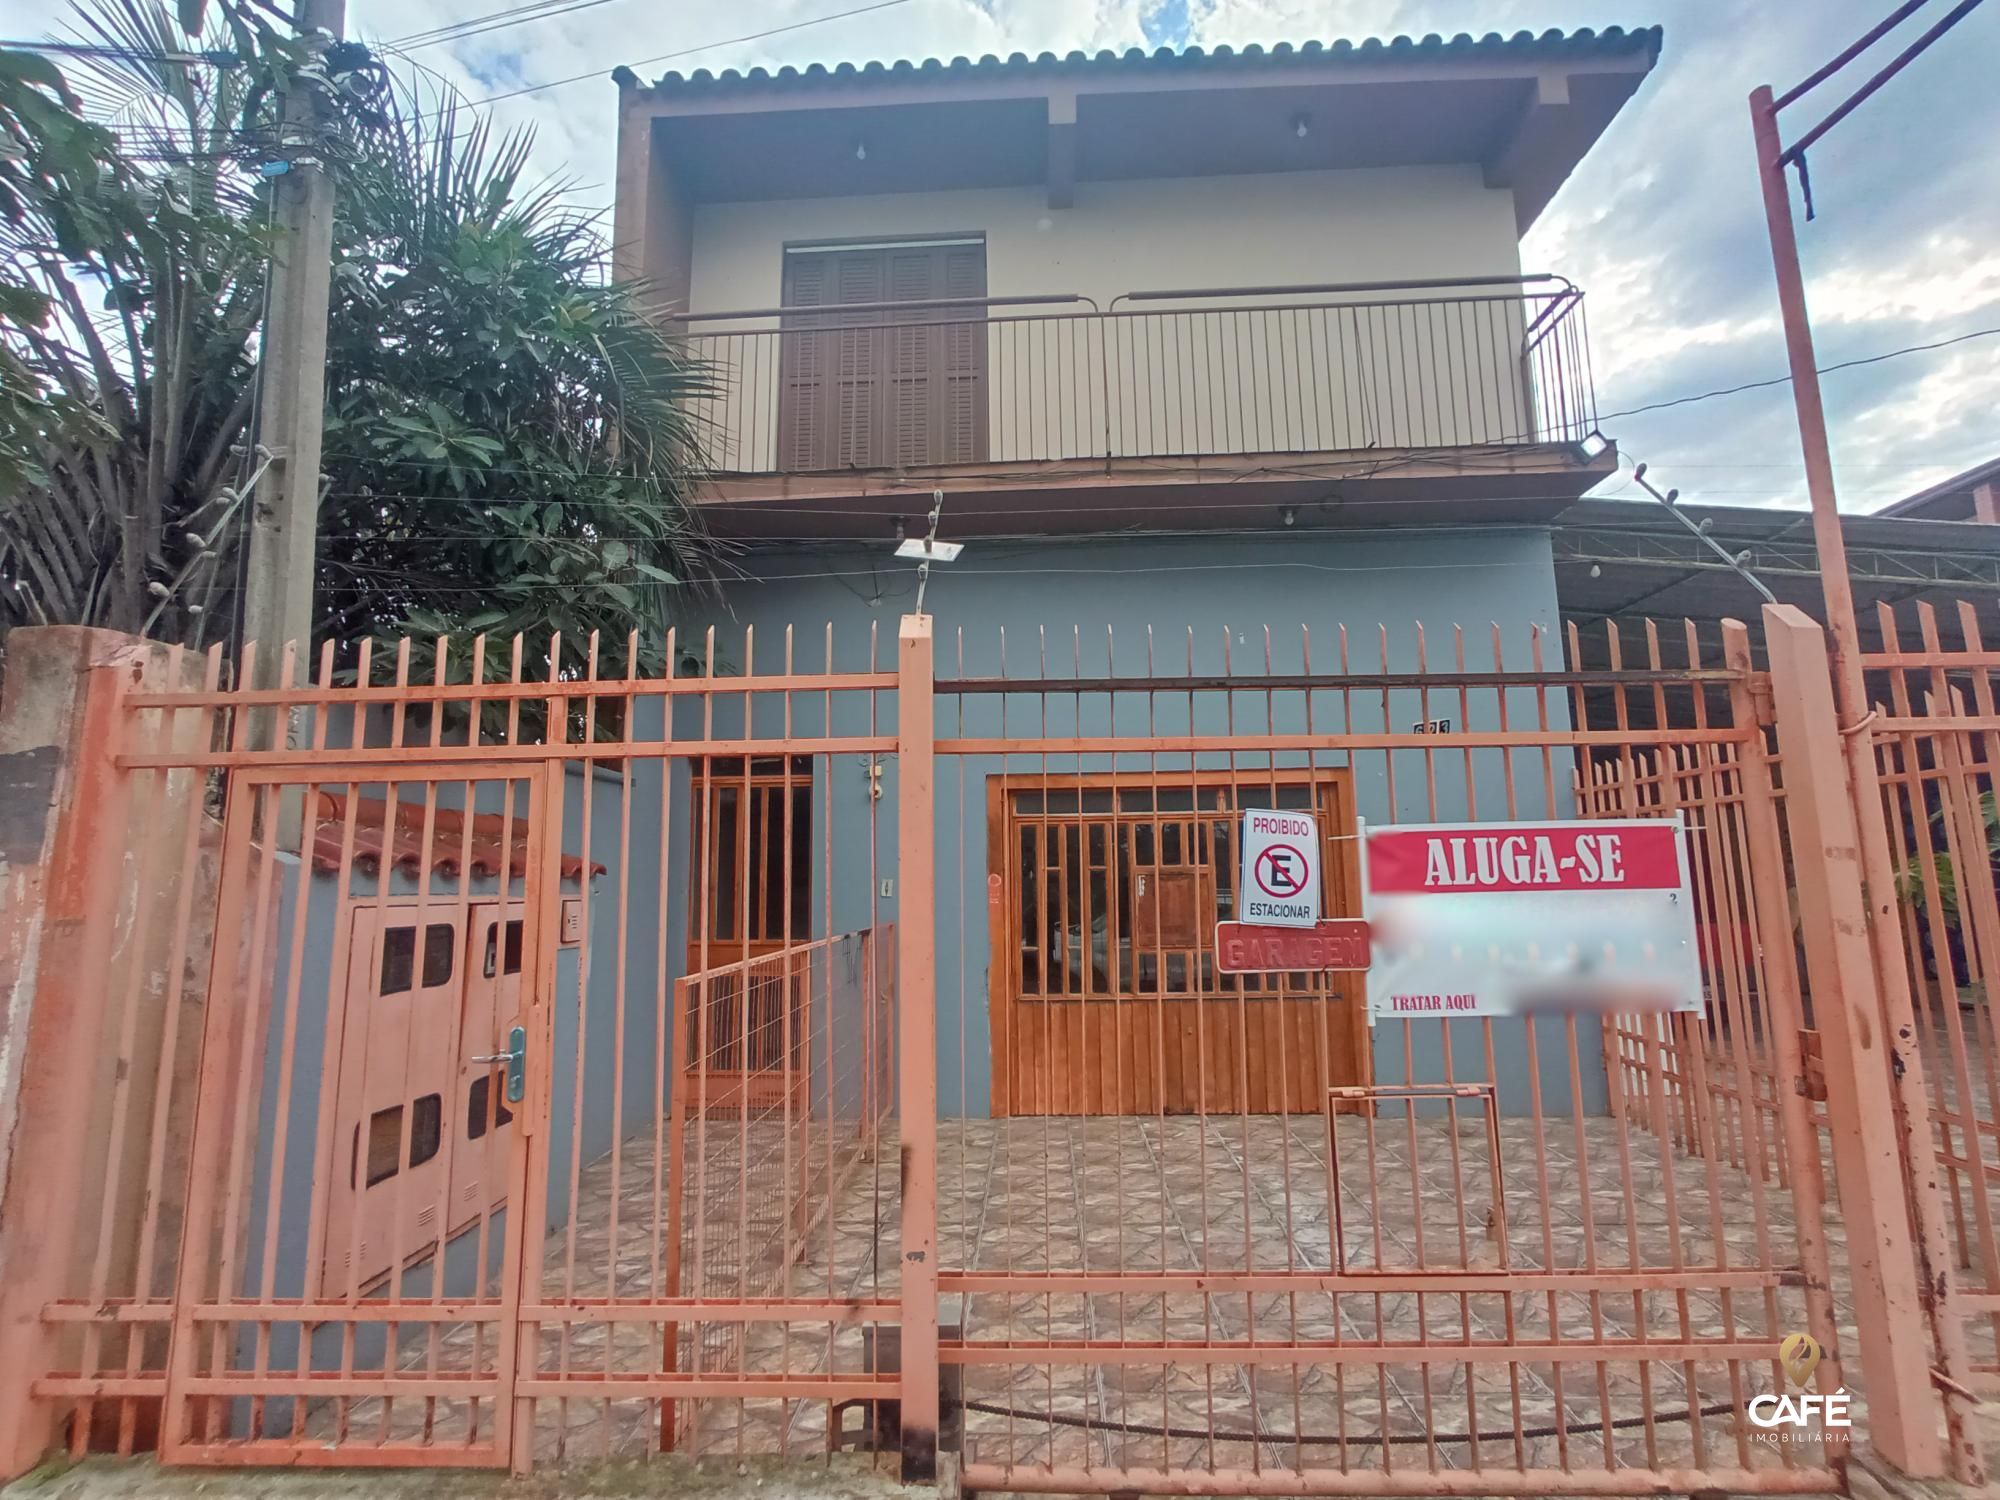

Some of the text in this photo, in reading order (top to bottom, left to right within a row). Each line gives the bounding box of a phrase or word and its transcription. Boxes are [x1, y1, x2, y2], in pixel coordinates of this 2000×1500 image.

[1253, 817, 1309, 837] PROIBIDO
[1424, 834, 1625, 886] ALUGA-SE
[1249, 902, 1311, 919] ESTACIONAR
[1225, 936, 1364, 968] GARAGEM
[1390, 994, 1477, 1011] TRATAR AQUI
